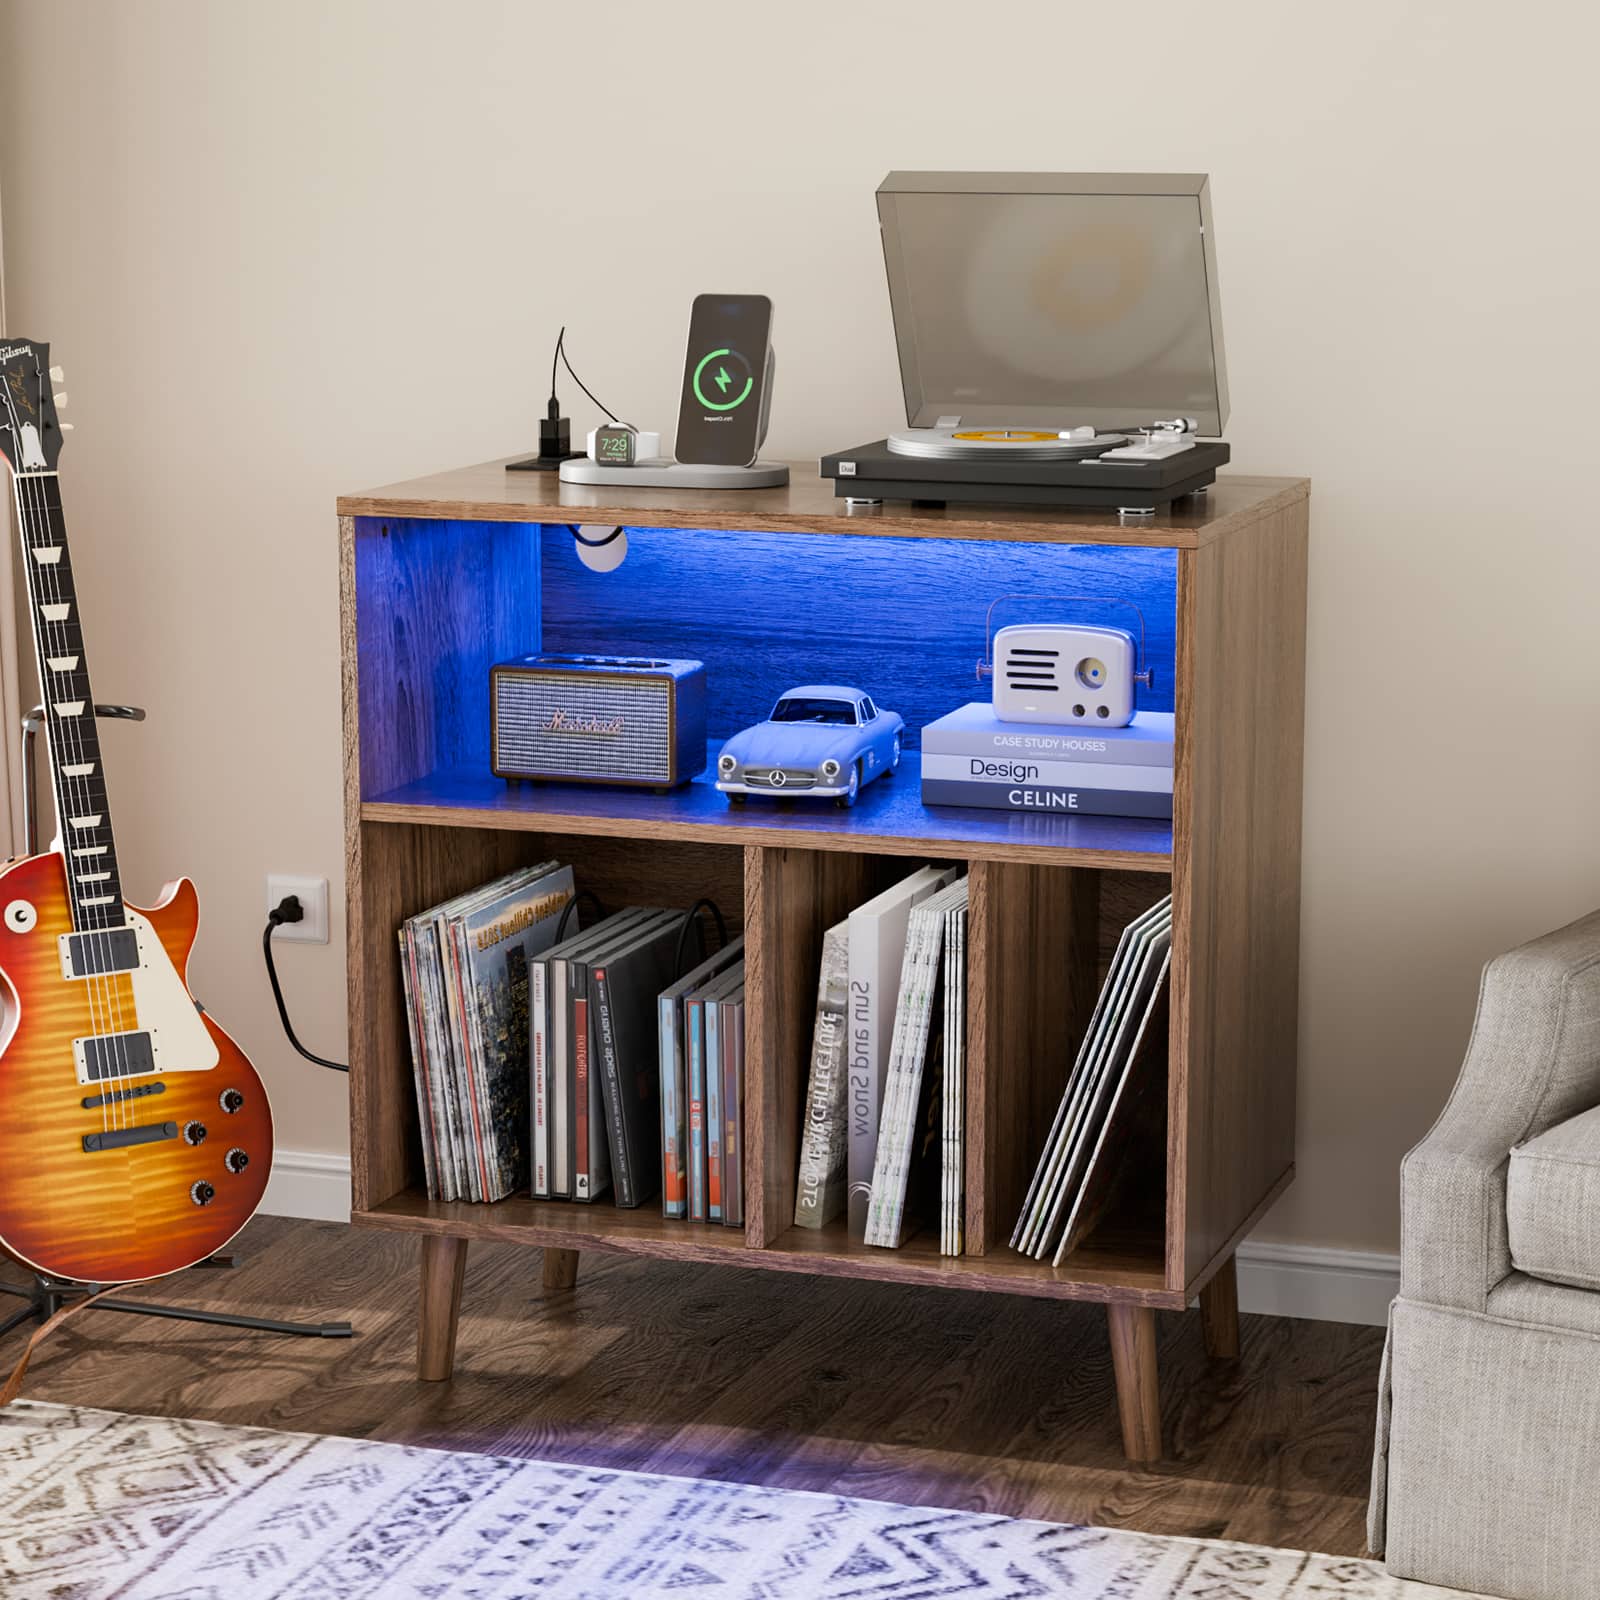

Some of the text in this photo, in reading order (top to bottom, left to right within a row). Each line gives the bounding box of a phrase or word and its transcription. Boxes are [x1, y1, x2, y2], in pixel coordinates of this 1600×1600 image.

[0, 345, 33, 365] Gibson
[601, 438, 627, 451] 7:29
[993, 736, 1107, 752] CASE STUDY HOUSES
[971, 758, 1039, 783] Design
[1008, 789, 1079, 809] CELINE
